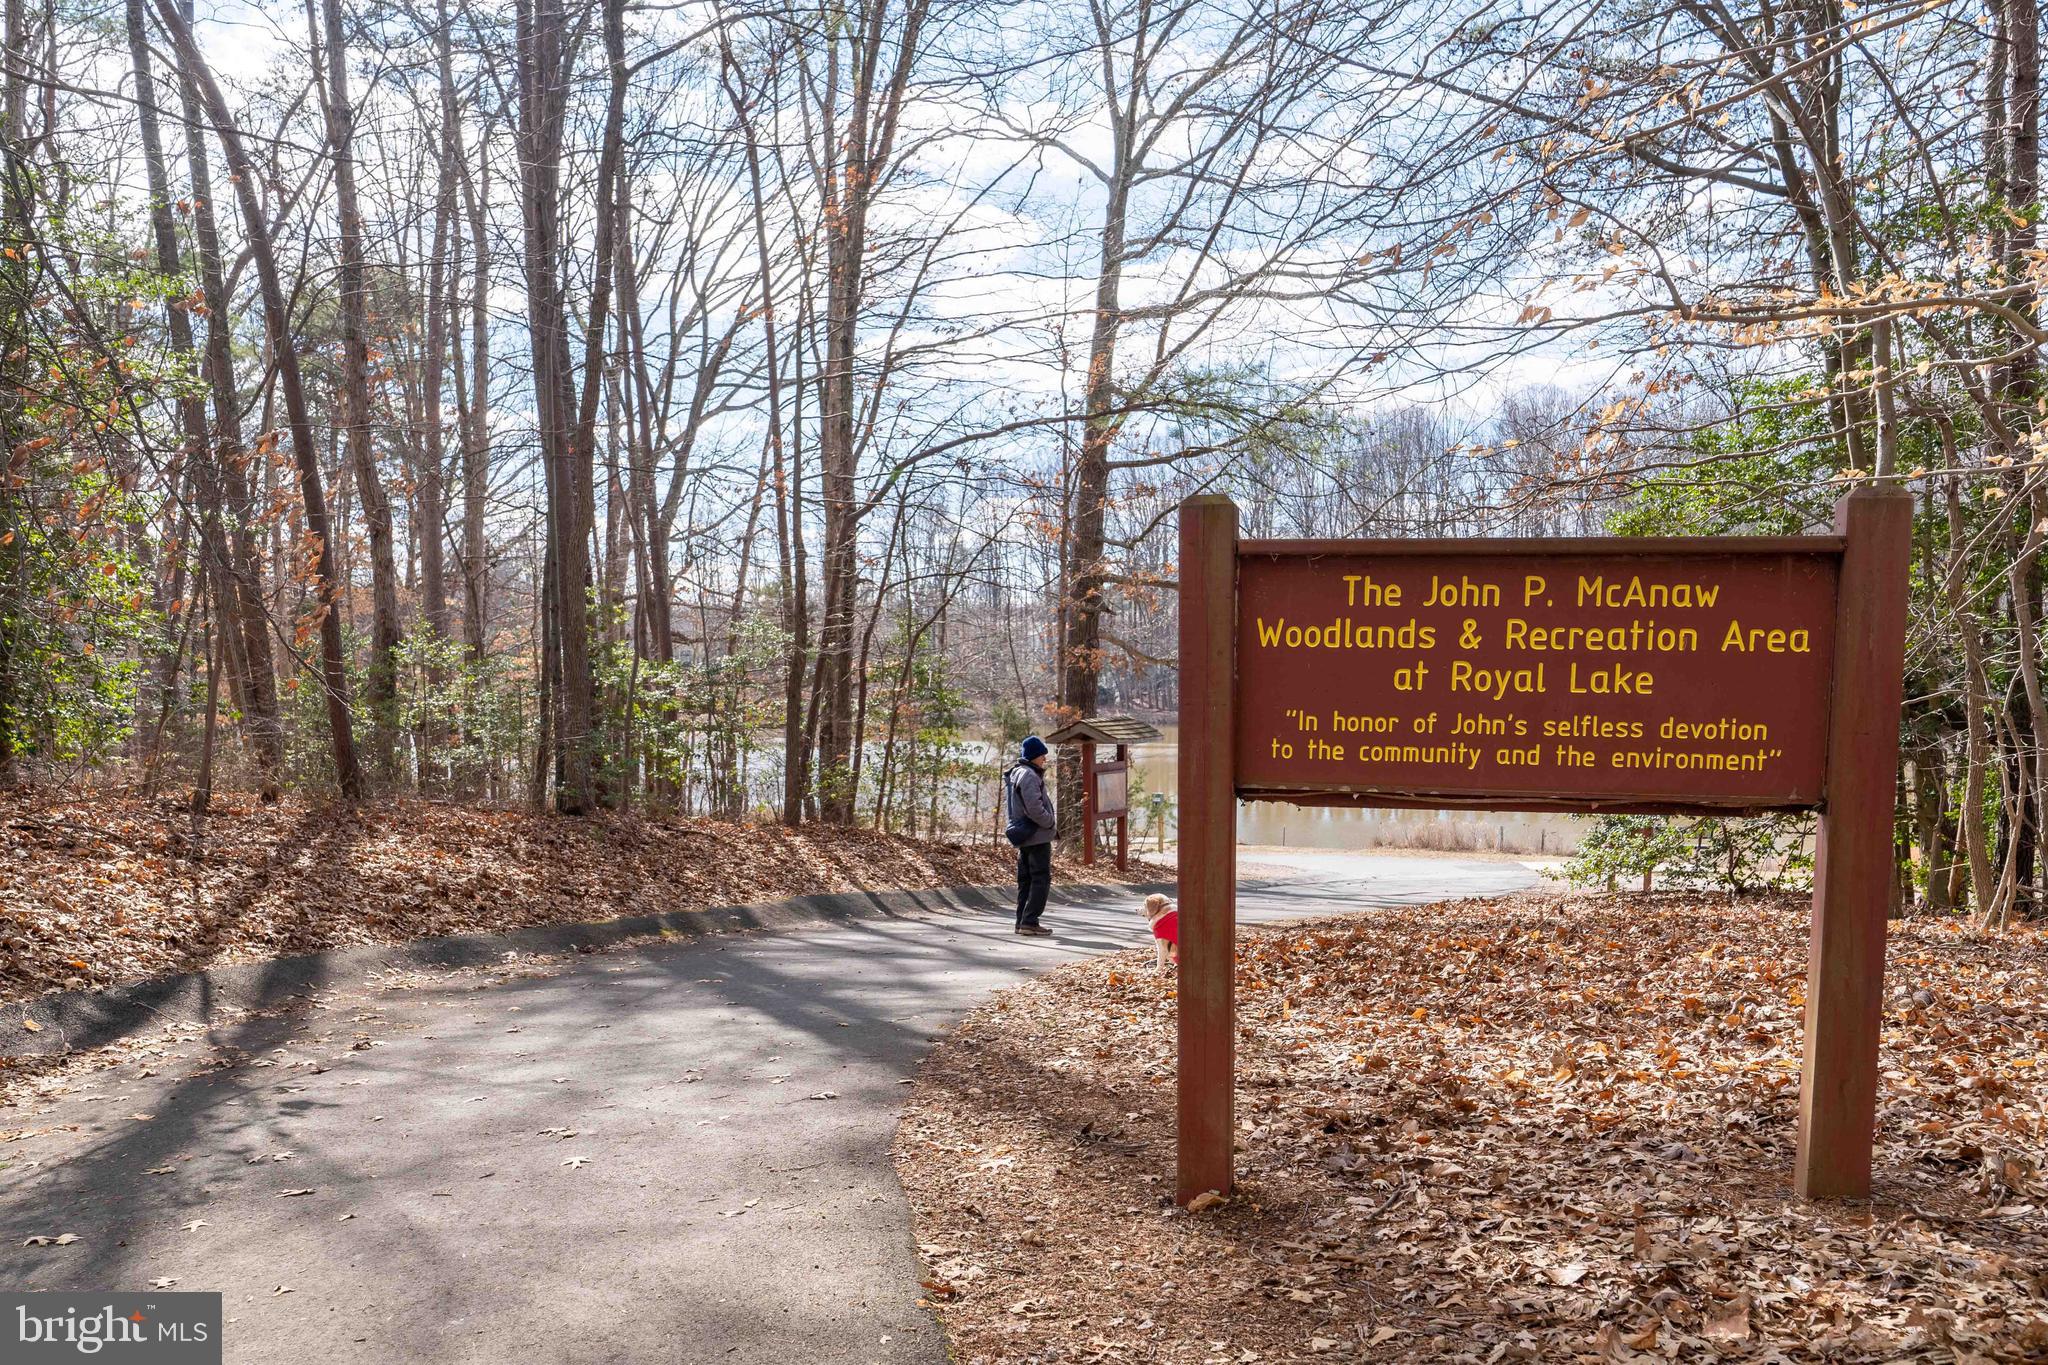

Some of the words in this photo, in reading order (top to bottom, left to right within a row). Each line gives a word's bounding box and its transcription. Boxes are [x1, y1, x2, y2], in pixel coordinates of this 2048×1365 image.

[1343, 575, 1402, 607] The
[1422, 575, 1501, 608] John
[1524, 575, 1553, 608] P.
[1577, 575, 1720, 608] McAnaw
[1256, 617, 1437, 649] Woodlands
[1458, 618, 1483, 650] &
[1505, 618, 1698, 652] Recreation
[1720, 619, 1811, 653] Area
[1393, 660, 1430, 691] at
[1451, 661, 1547, 701] Royal
[1569, 662, 1654, 695] Lake
[1333, 710, 1400, 733] honor
[1413, 711, 1438, 734] of
[1450, 712, 1528, 736] John's
[1543, 714, 1644, 739] selfless
[1659, 716, 1768, 741] devotion
[1271, 737, 1293, 760] to
[1307, 738, 1345, 761] the
[1359, 741, 1482, 770] community
[1496, 743, 1541, 766] and
[1555, 744, 1597, 767] the
[1611, 746, 1782, 772] environment"
